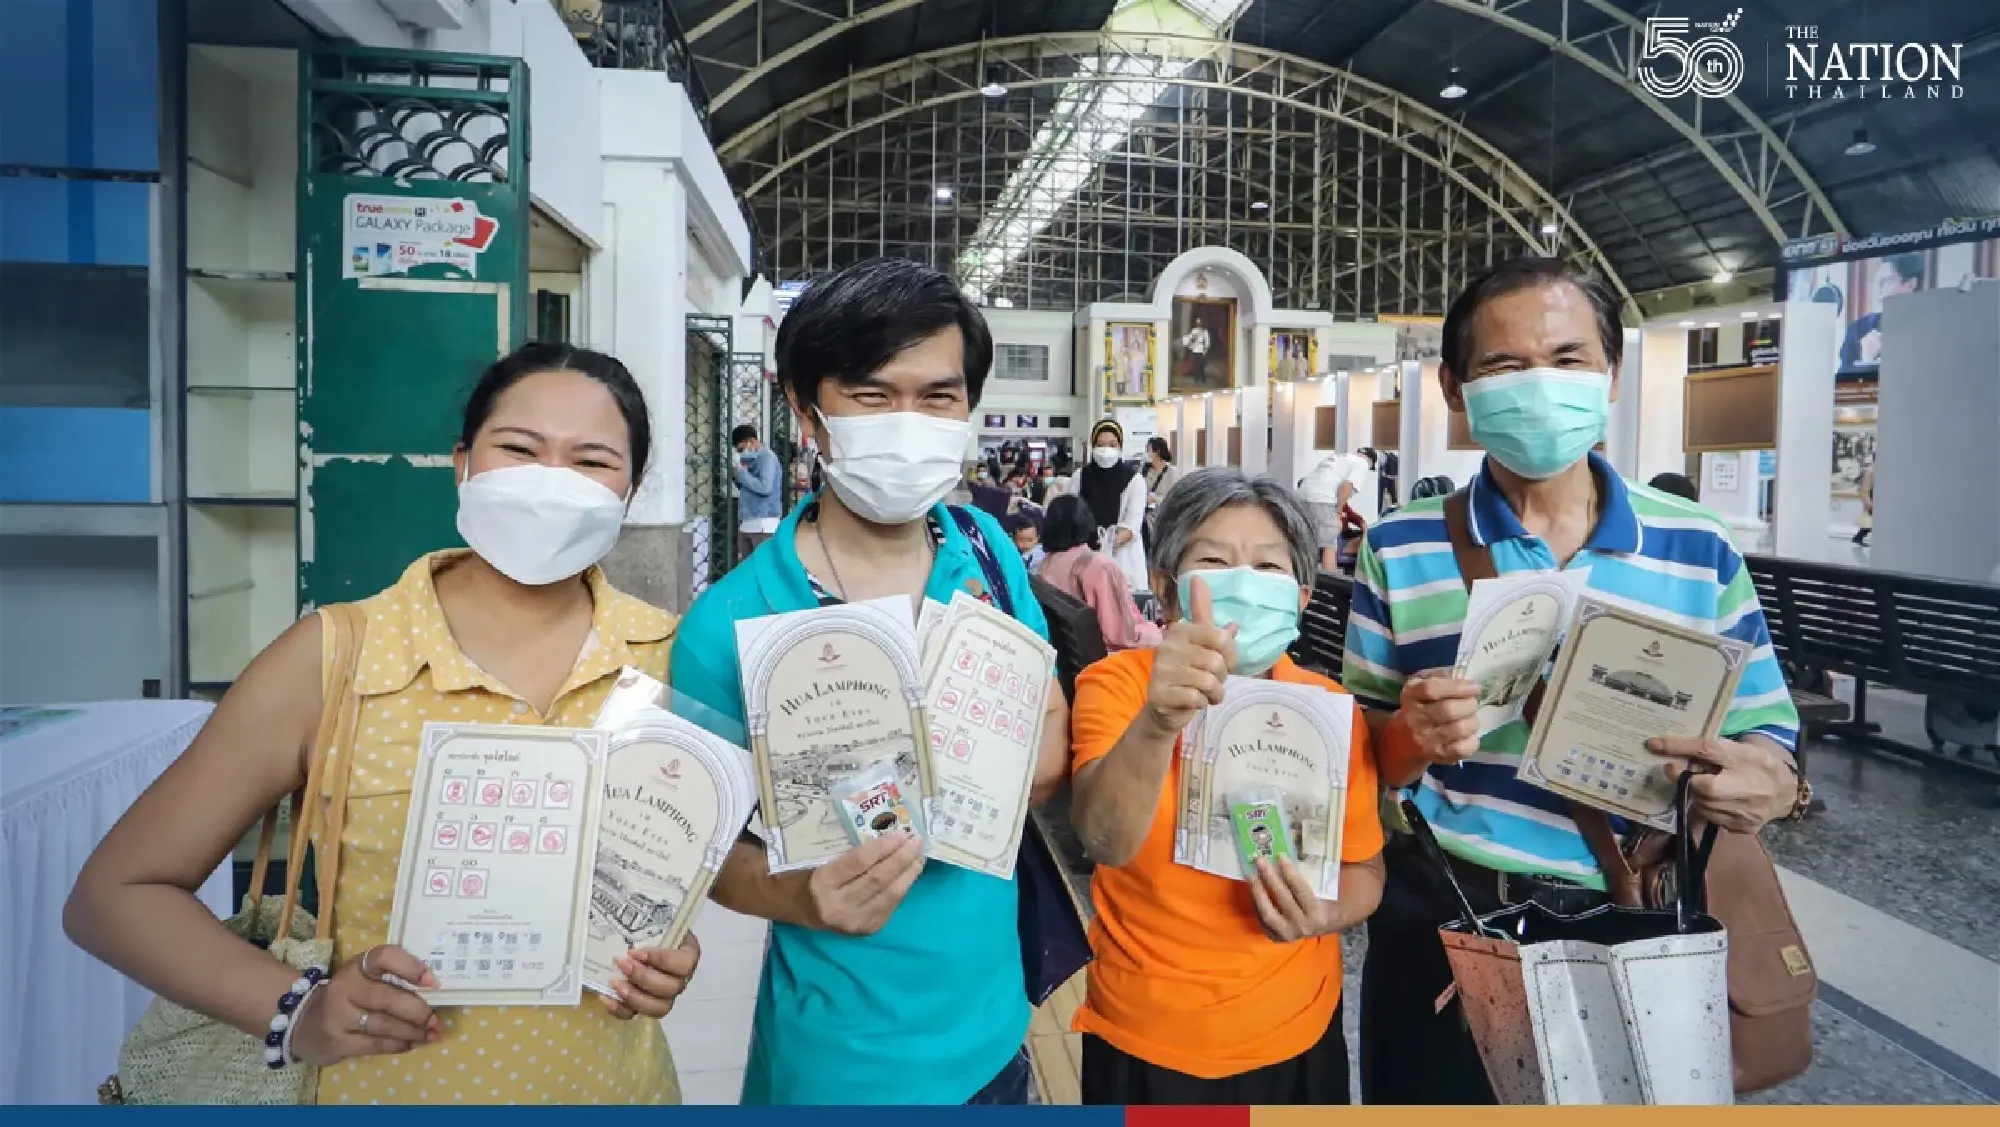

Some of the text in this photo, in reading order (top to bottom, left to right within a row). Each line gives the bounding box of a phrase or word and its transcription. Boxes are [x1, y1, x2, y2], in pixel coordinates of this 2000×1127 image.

[357, 203, 384, 214] true
[356, 217, 472, 236] GALAXY Package
[399, 244, 416, 257] 50
[779, 680, 890, 716] HUA LAMPHONG
[1227, 739, 1318, 773] HUA LAMPHONG
[634, 785, 699, 842] LAMPHONG
[859, 790, 887, 814] SRT
